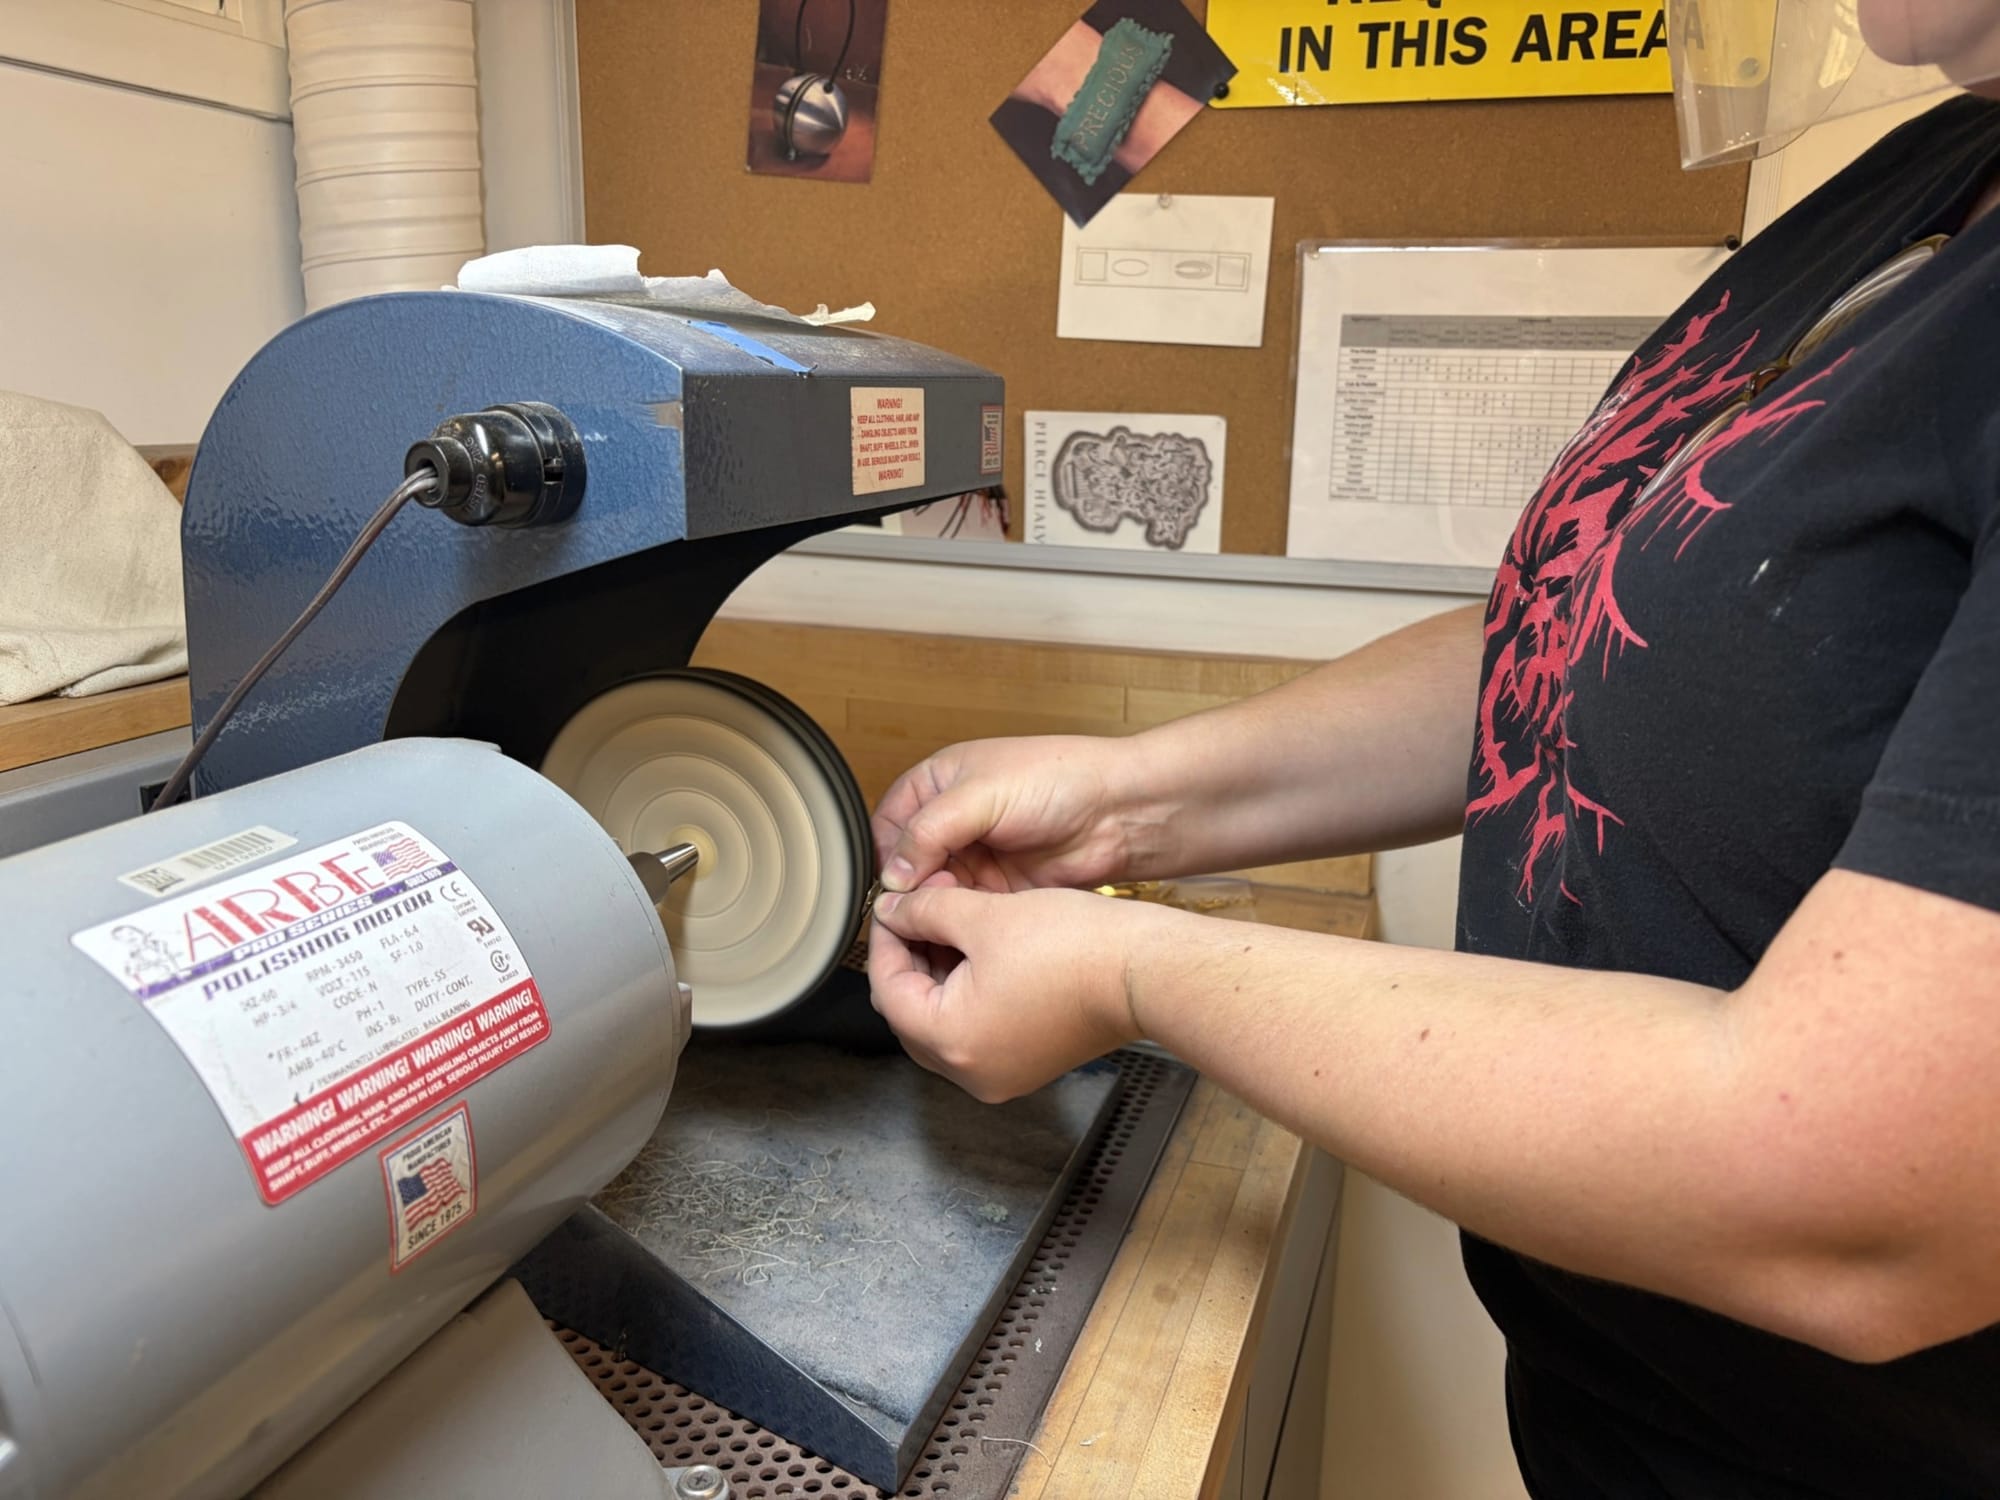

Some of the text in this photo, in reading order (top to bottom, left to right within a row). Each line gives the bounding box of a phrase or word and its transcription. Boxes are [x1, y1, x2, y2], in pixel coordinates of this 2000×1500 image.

[1279, 24, 1333, 73] IN
[1358, 16, 1488, 70] THIS
[1071, 43, 1144, 151] PRECIOUS
[877, 398, 903, 409] WARNING!
[878, 468, 904, 480] WARNING!
[1034, 421, 1047, 478] PIERCE
[183, 852, 386, 962] ARBE
[232, 895, 372, 960] PRO SERIES
[203, 890, 434, 1001] POLISHING MOTOR
[252, 987, 534, 1161] WARNING! WARNING! WARNING! WARNING!
[417, 1088, 428, 1100] IN
[427, 1079, 447, 1096] USE.
[446, 1060, 479, 1084] SERIOUS
[478, 1046, 504, 1066] INJURY
[503, 1036, 520, 1050] CAN
[518, 1020, 545, 1041] RESULT.
[264, 1154, 293, 1179] KEEP
[293, 1145, 313, 1162] ALL
[387, 1087, 407, 1104] AND
[406, 1077, 426, 1095] ANY
[425, 1053, 468, 1082] DANGLING
[467, 1035, 499, 1058] OBJECTS
[498, 1024, 520, 1040] AWAY
[518, 1010, 540, 1028] FROM
[402, 1126, 452, 1161] PROUD AMERICAN
[407, 1139, 452, 1171] MANUFACTURER
[408, 1201, 463, 1250] SINCE 1975
